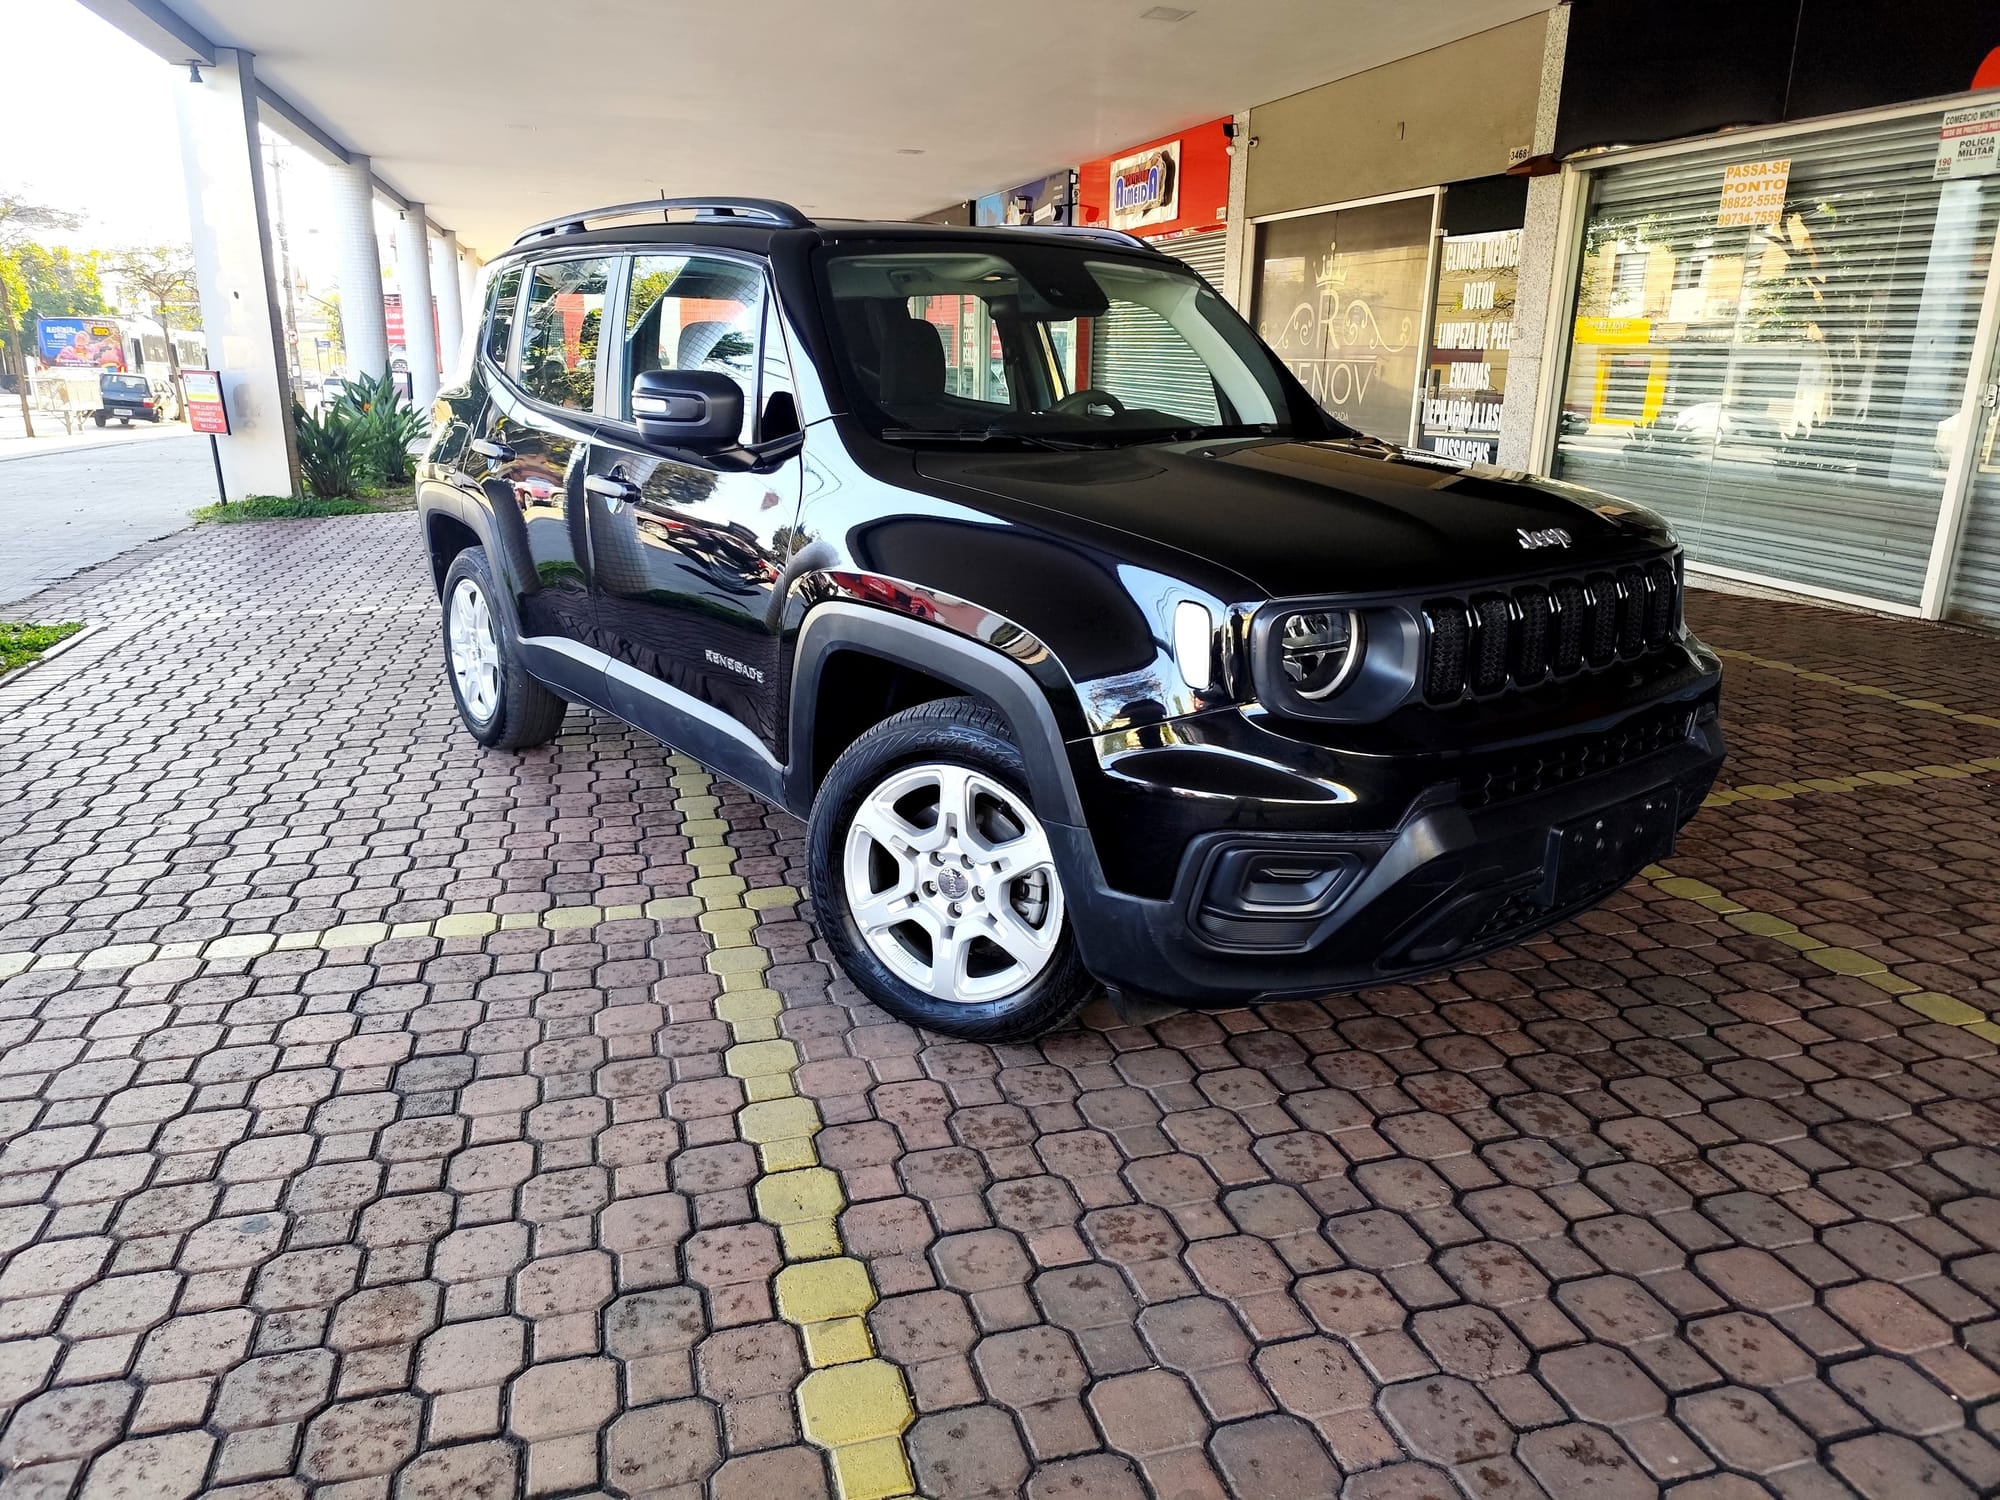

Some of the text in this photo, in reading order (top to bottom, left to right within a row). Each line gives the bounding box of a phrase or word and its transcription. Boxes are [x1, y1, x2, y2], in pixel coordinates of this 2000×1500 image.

[1510, 149, 1527, 161] 3468
[1957, 146, 1995, 158] MILITAR
[1726, 160, 1789, 179] PASSA-SE
[1938, 156, 1952, 167] 190
[1723, 178, 1786, 195] PONTO
[1721, 193, 1784, 210] 98822-5555
[1718, 210, 1781, 226] 99734-7559
[1462, 281, 1496, 310] BOTOX
[1437, 322, 1476, 350] LIMPEZA
[1476, 322, 1491, 350] DE
[1449, 362, 1491, 390] ENZIMAS
[1516, 528, 1572, 550] Jeep
[705, 649, 765, 684] RENEGADE
